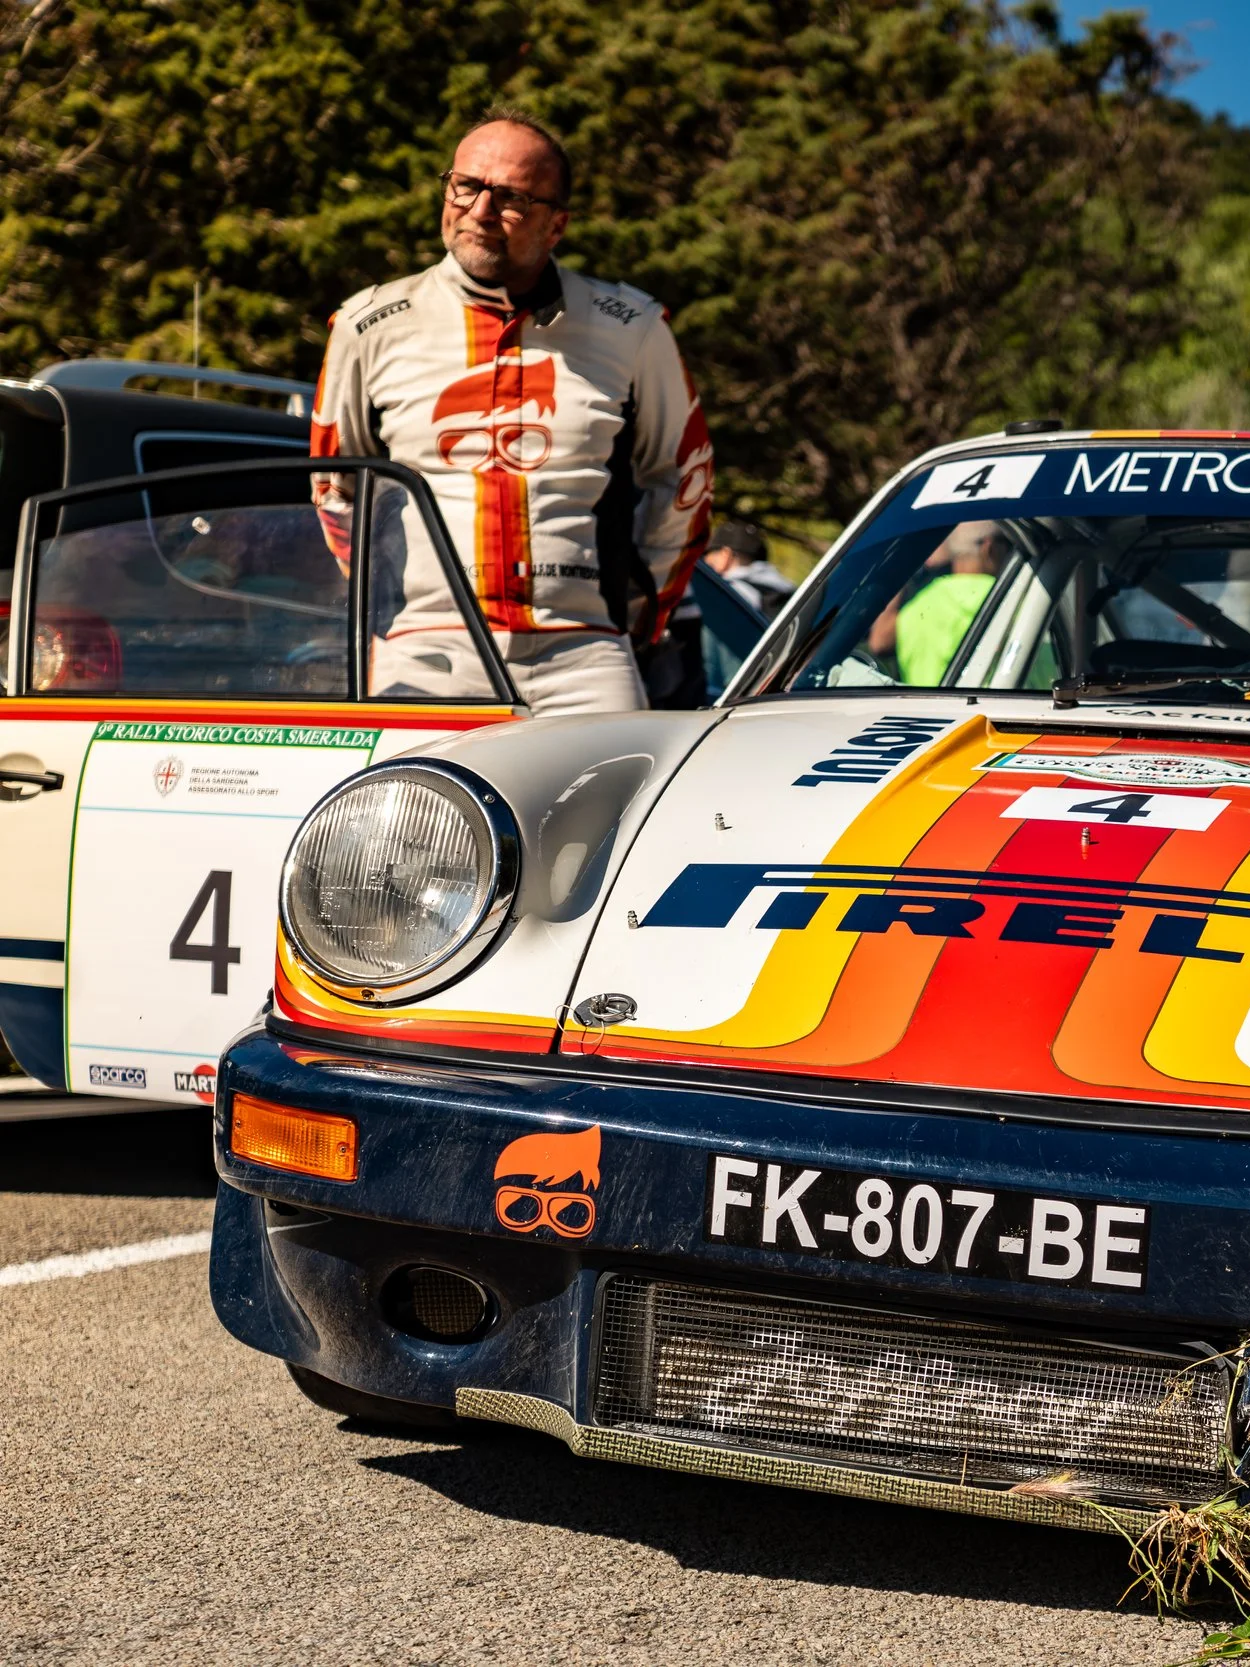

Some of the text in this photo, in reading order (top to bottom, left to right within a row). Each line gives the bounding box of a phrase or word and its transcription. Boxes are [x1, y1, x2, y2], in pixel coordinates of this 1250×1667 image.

[953, 464, 997, 498] 4
[113, 726, 165, 741] RALLY
[164, 727, 235, 743] STORICO
[234, 729, 286, 744] COSTA
[286, 730, 375, 747] SMERALDA
[791, 716, 956, 787] MOTUL
[1067, 793, 1154, 823] 4
[169, 869, 241, 995] 4
[176, 1073, 216, 1093] MART
[710, 1156, 1147, 1288] FK-807-BE
